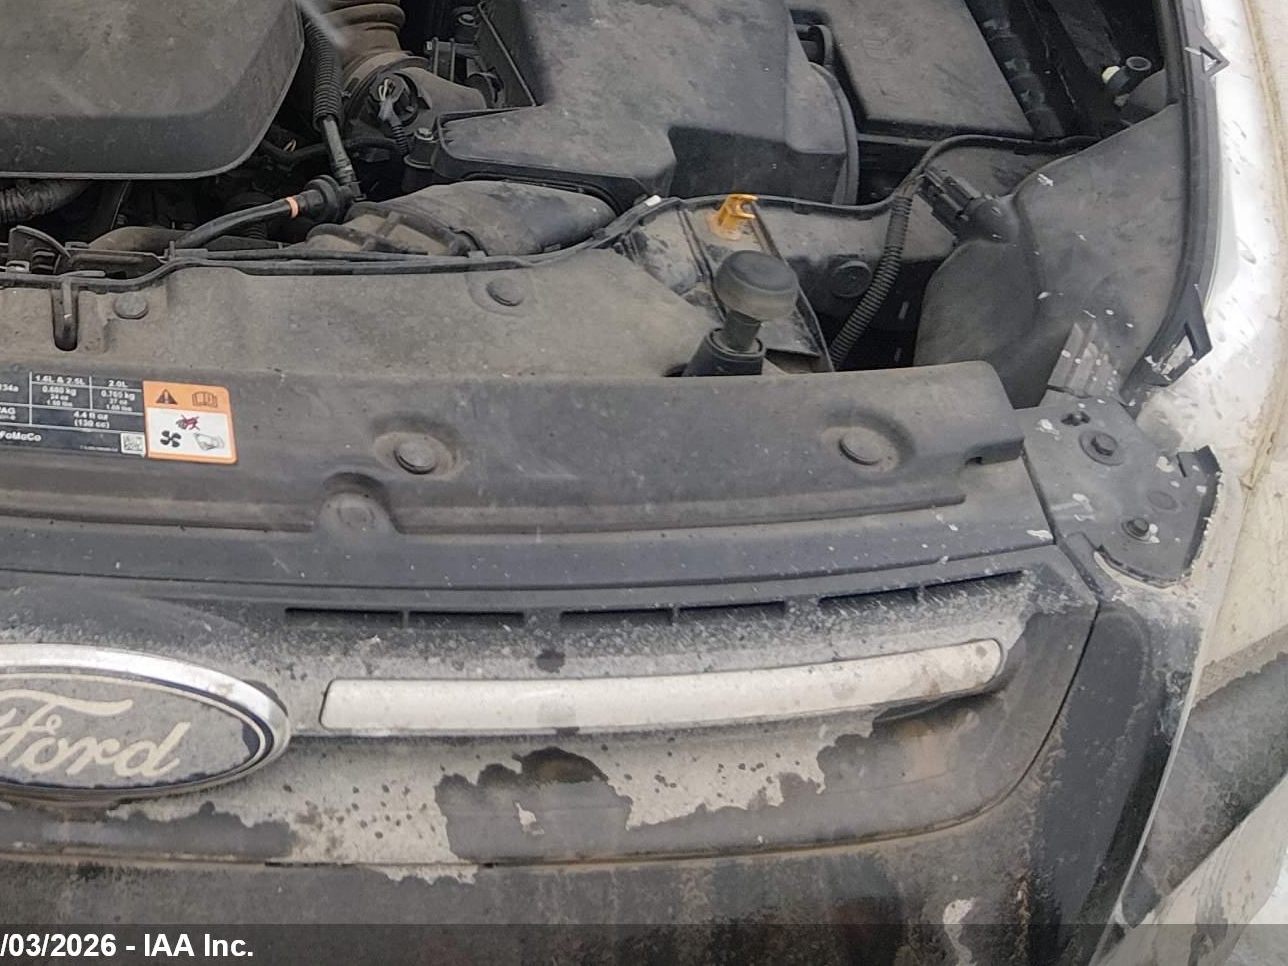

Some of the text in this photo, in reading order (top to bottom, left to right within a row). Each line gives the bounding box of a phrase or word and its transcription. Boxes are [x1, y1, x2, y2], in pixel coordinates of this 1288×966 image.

[108, 380, 128, 388] 2.0L
[65, 388, 77, 397] kg
[124, 392, 136, 401] kg
[73, 411, 87, 419] 4.4
[97, 413, 109, 421] oz
[0, 430, 42, 442] FoMoCo
